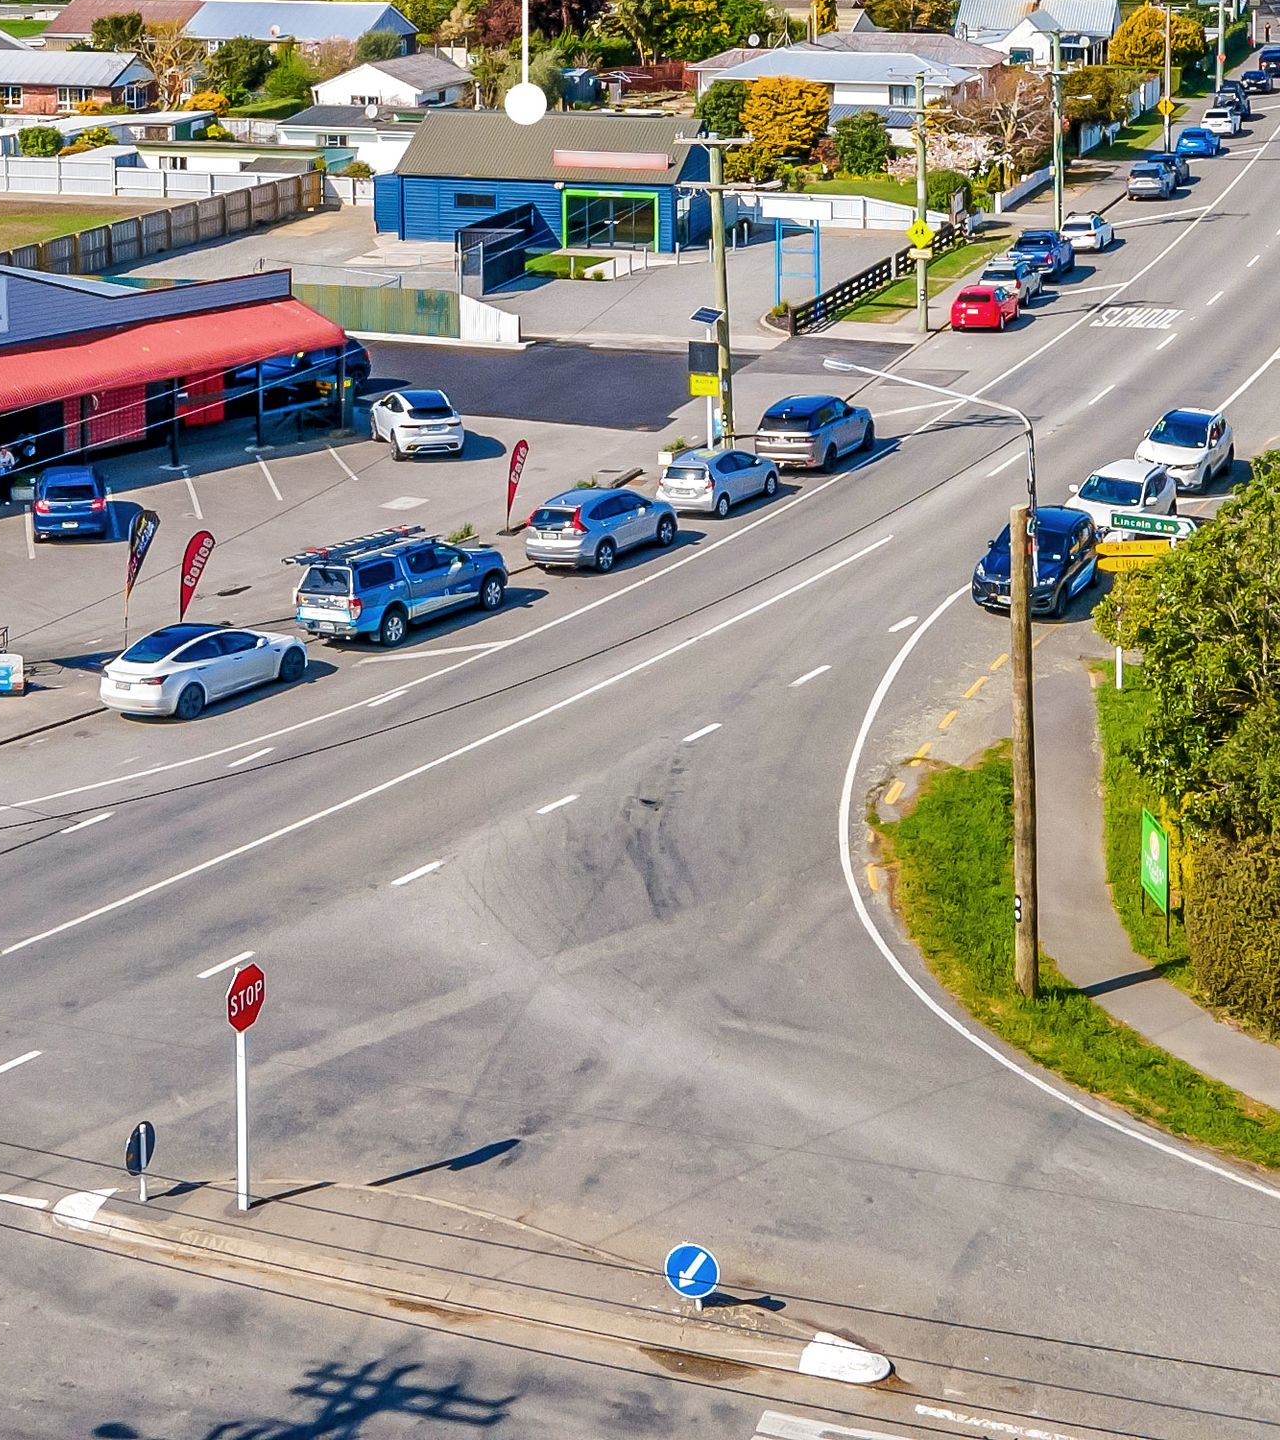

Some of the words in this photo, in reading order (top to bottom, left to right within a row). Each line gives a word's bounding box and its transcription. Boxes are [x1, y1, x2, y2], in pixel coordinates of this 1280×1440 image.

[1089, 307, 1185, 329] SCHOOL
[510, 446, 528, 485] Cafe
[1113, 516, 1151, 530] Lincoln
[1154, 521, 1162, 531] 6
[183, 537, 214, 588] Coffee
[230, 979, 263, 1017] STOP
